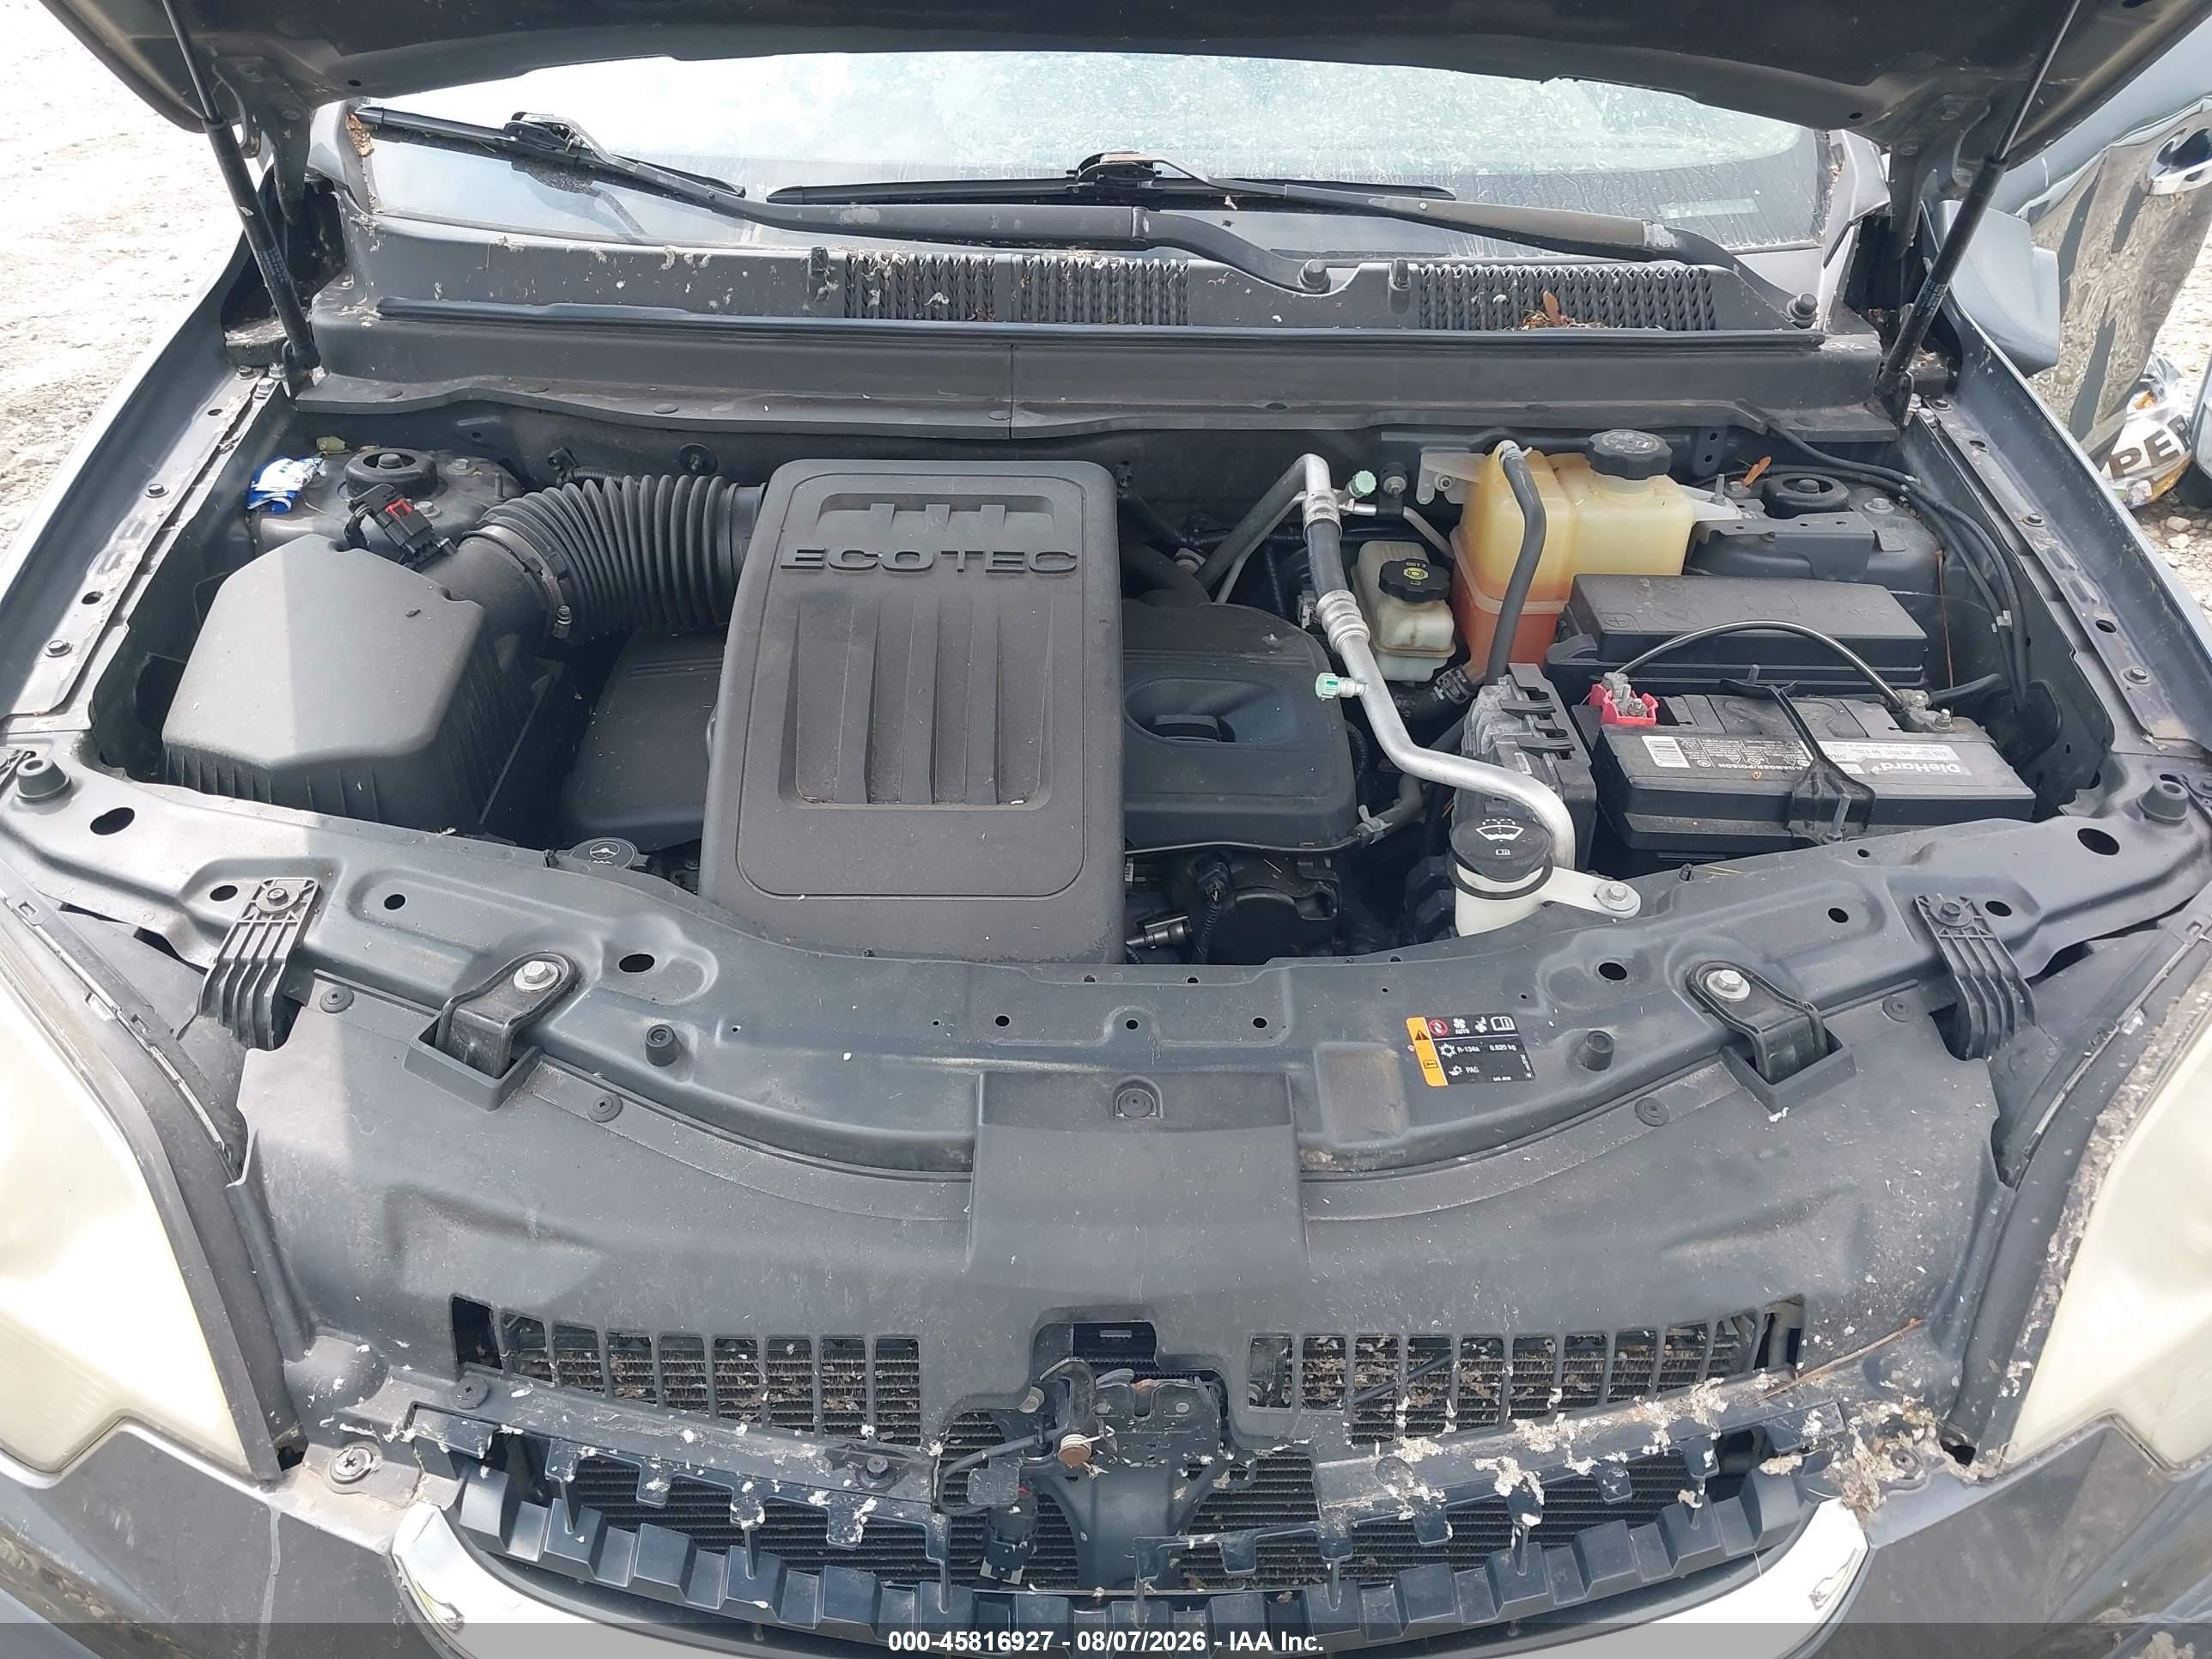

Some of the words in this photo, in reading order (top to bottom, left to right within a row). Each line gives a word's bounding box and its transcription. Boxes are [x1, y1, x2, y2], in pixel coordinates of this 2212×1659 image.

[781, 547, 1078, 574] ECOTEC
[1881, 762, 1961, 773] DieHard
[1507, 1043, 1517, 1052] kg
